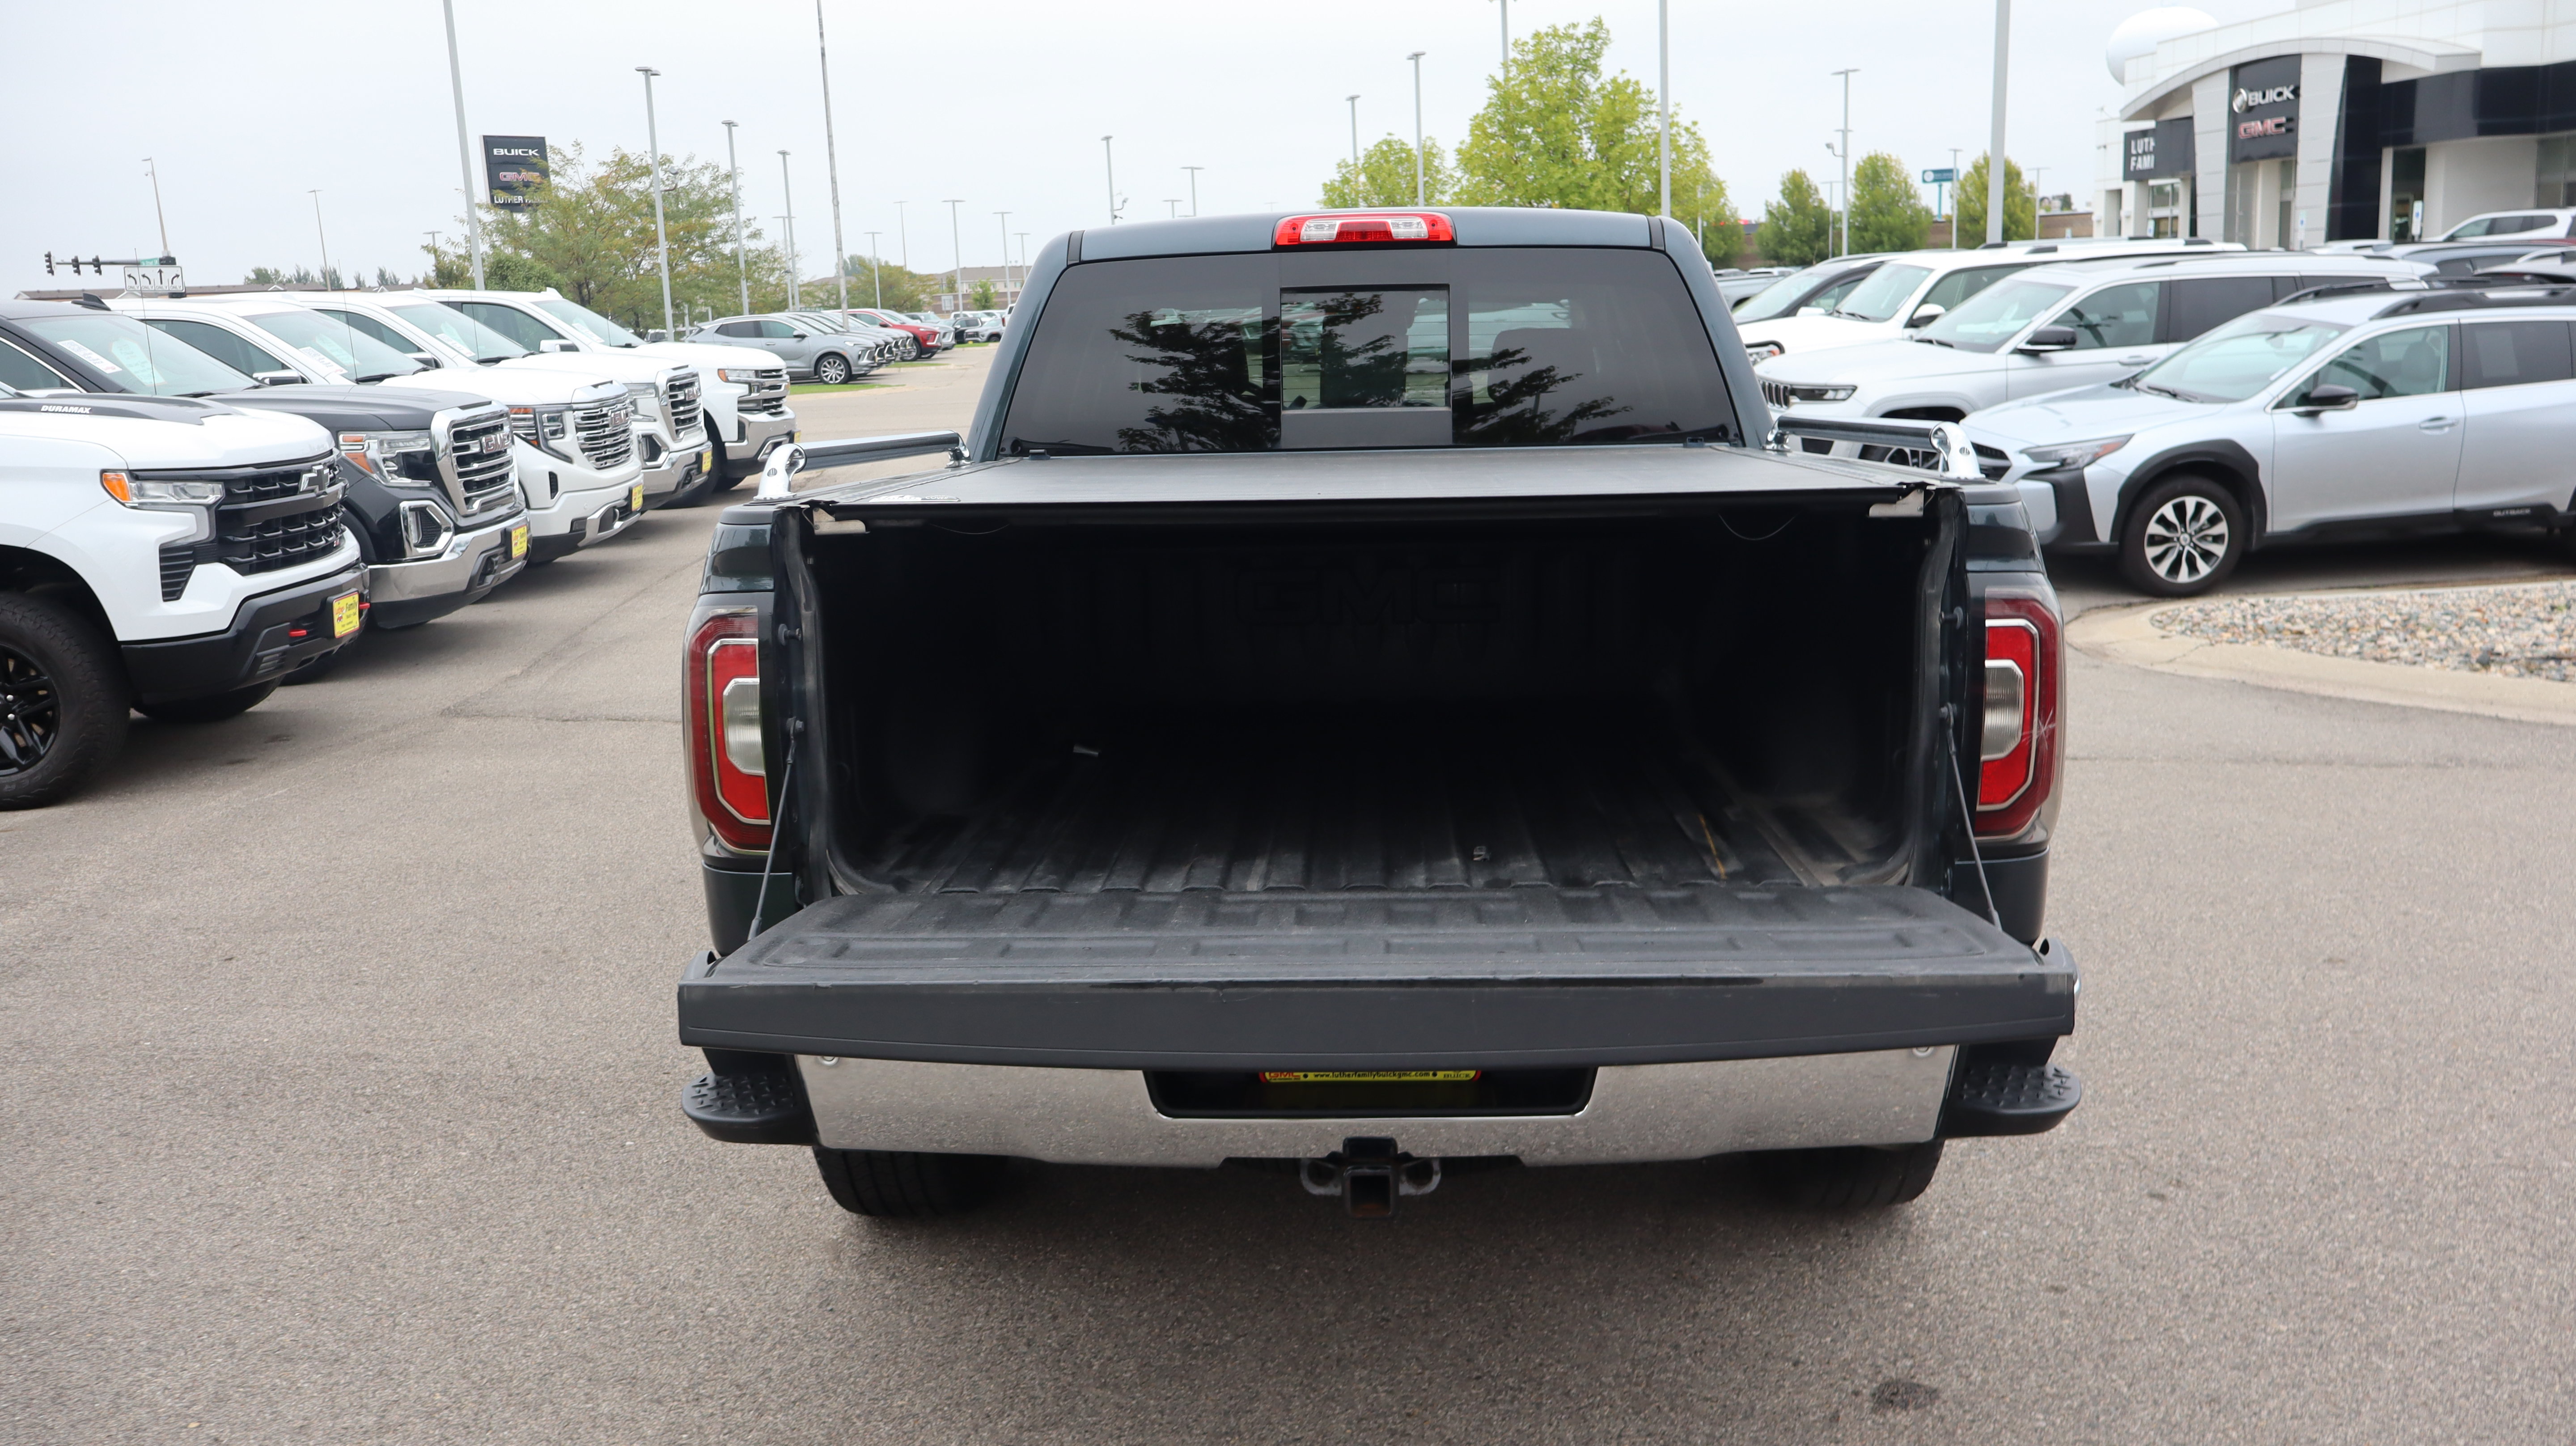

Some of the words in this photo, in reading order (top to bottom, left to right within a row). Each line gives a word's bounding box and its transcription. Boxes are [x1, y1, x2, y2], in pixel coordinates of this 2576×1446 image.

[2248, 85, 2295, 106] BUICK
[2238, 116, 2286, 139] GMC
[493, 148, 540, 156] BUICK
[499, 172, 540, 182] GMC
[41, 405, 91, 414] DURAMAX
[1235, 566, 1502, 626] GMC
